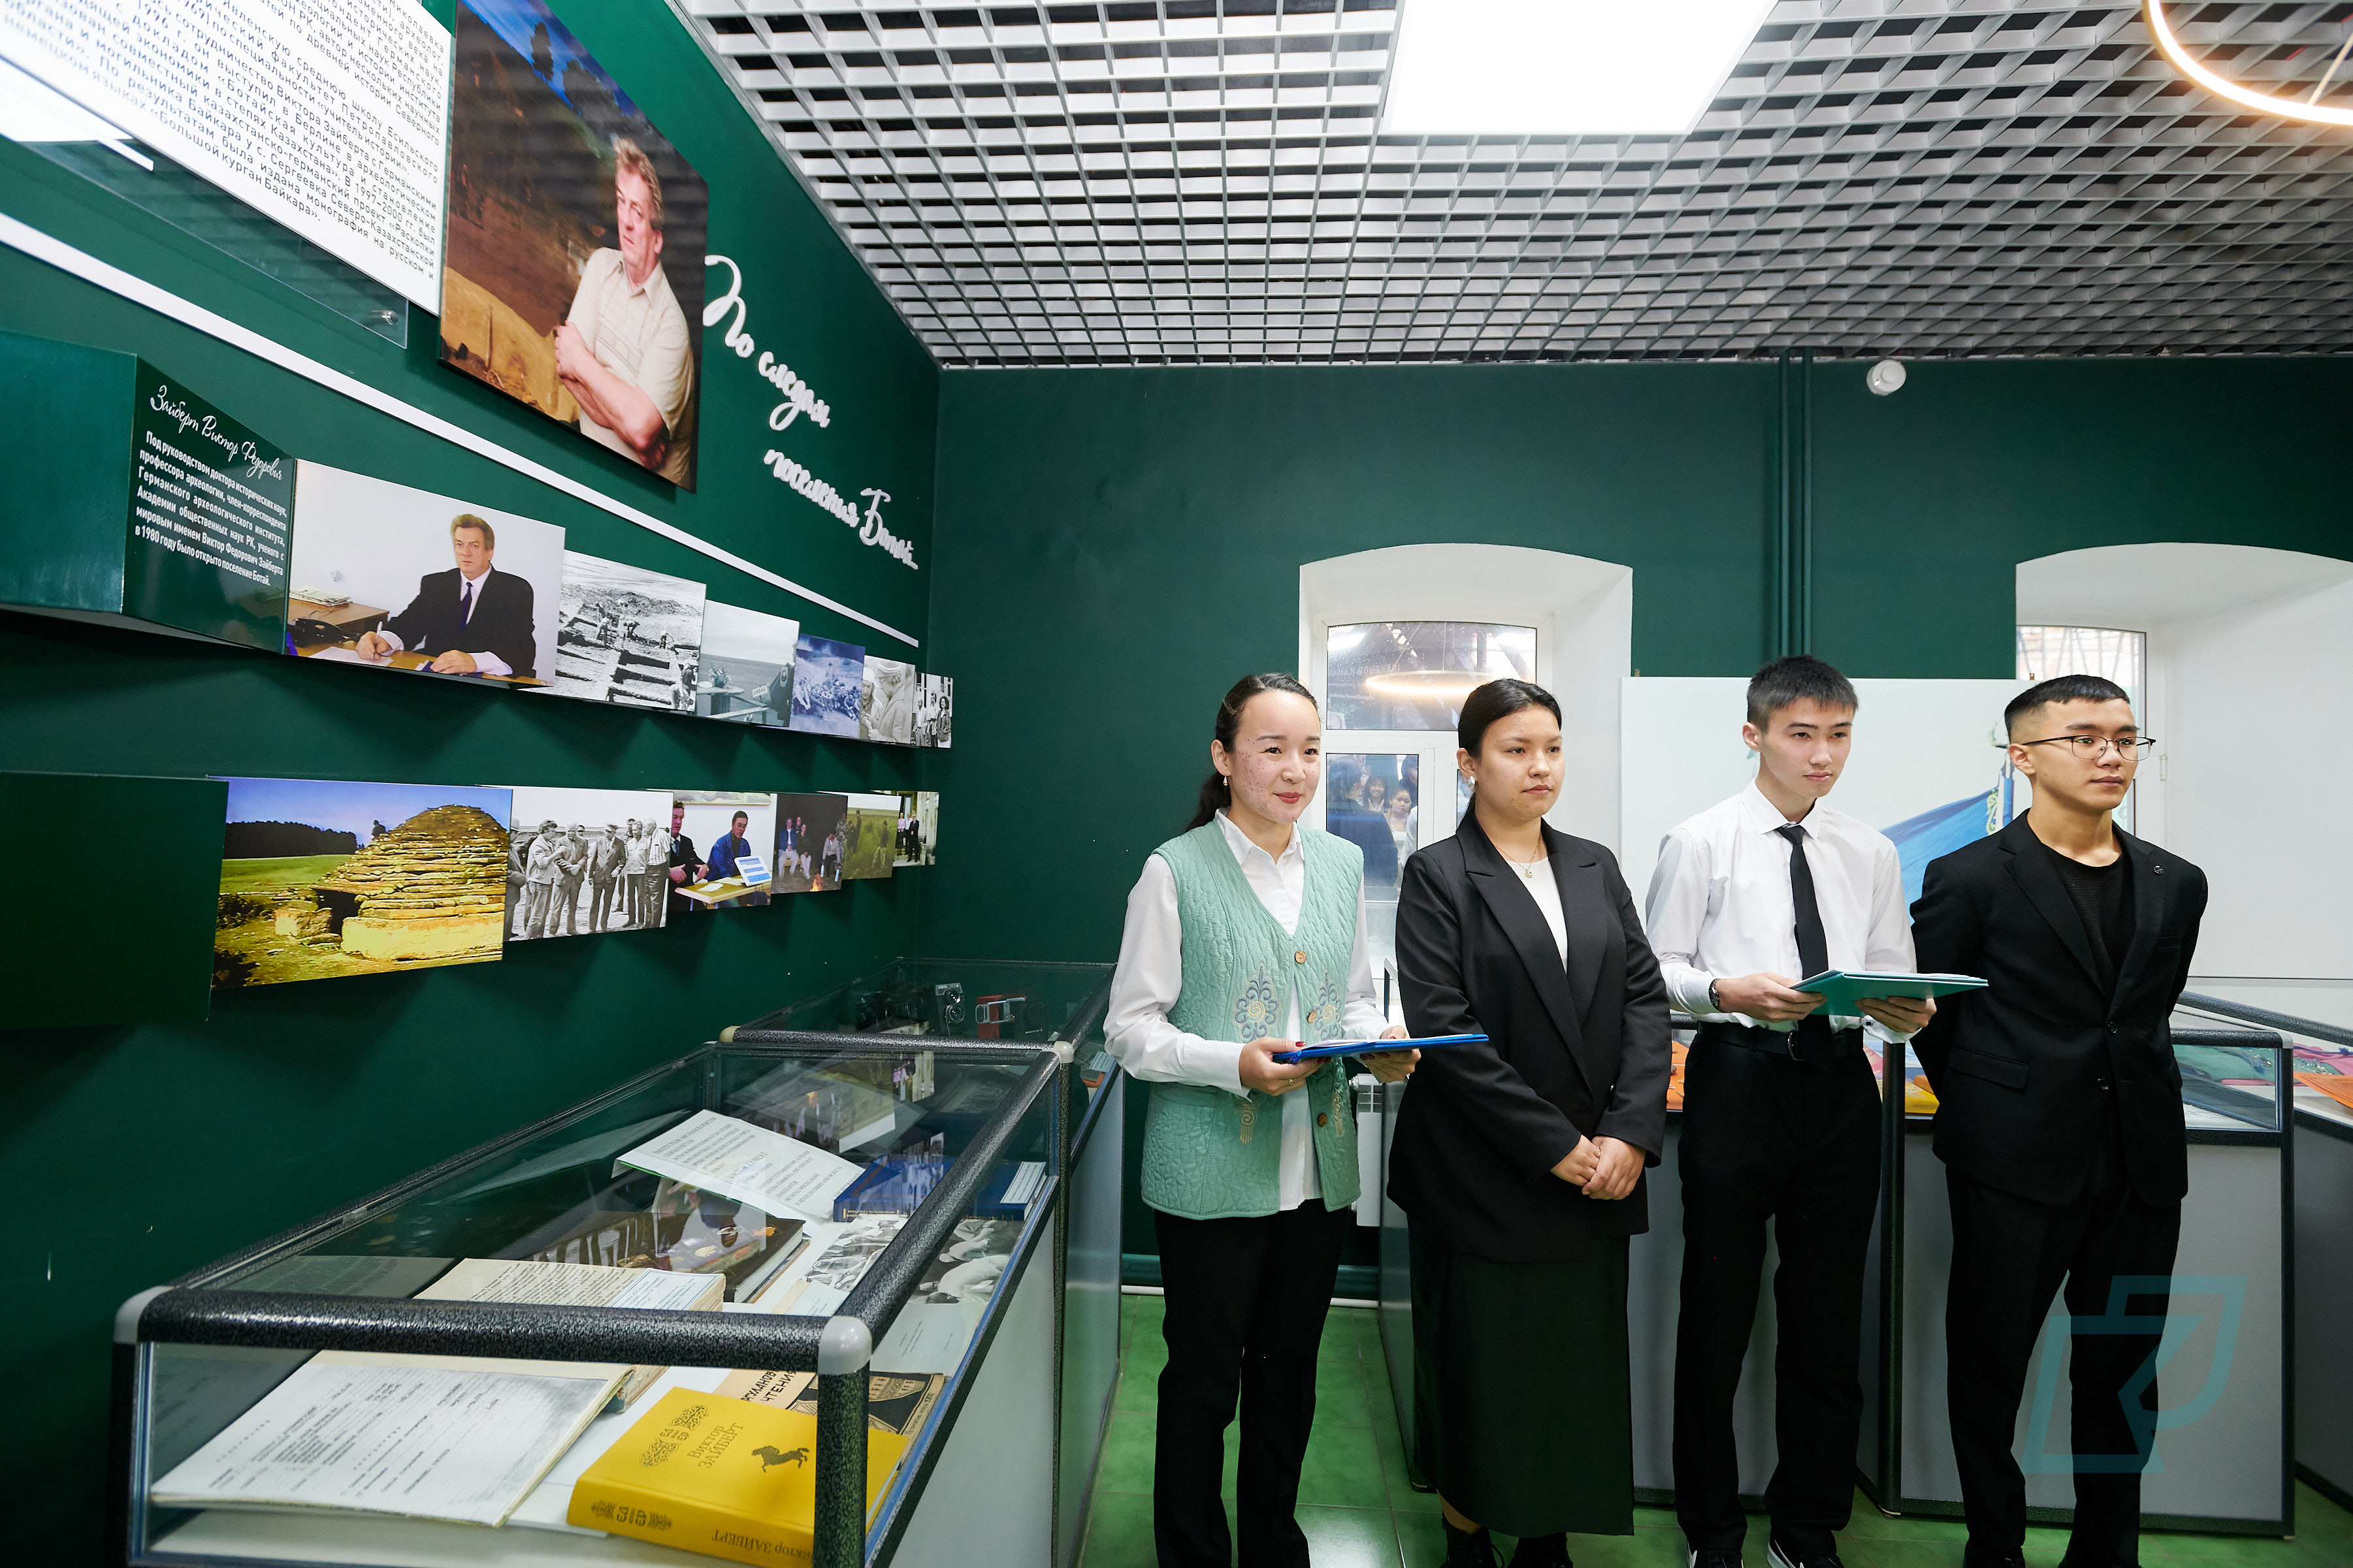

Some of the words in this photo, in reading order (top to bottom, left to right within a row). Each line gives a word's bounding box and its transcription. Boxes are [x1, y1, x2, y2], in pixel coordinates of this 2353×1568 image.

[280, 0, 295, 14] ОН
[299, 9, 316, 33] РК,
[319, 29, 347, 57] автор
[349, 54, 402, 103] нескольких
[404, 100, 439, 135] научных
[327, 0, 371, 37] ондент
[377, 36, 441, 99] Германского
[347, 0, 414, 63] исторических
[419, 63, 442, 89] наук,
[358, 48, 395, 84] истории
[399, 84, 440, 123] института
[368, 44, 389, 67] наук
[391, 61, 440, 110] Республики
[400, 20, 443, 66] археолог,
[408, 40, 428, 63] века
[131, 14, 208, 73] докладом
[217, 75, 295, 135] «Ботайская
[302, 134, 354, 176] культура
[372, 184, 435, 233] становление
[152, 0, 171, 15] сь
[175, 12, 273, 90] сотрудничество
[276, 84, 321, 125] Виктора
[323, 120, 369, 161] Зайберта
[378, 159, 436, 210] Германскими
[195, 0, 263, 50] ический
[270, 50, 334, 104] факультет
[341, 103, 437, 184] Петропавловского
[229, 33, 315, 104] специальности
[317, 101, 363, 140] «учитель
[365, 136, 409, 175] истории».
[297, 57, 346, 100] среднюю
[351, 99, 382, 130] школу
[387, 125, 438, 172] Есильского
[306, 33, 349, 73] древней
[354, 71, 391, 107] истории
[395, 103, 439, 146] Северного
[96, 39, 182, 102] могильника
[188, 97, 241, 141] Байкара
[270, 152, 326, 198] Сергеевка
[331, 193, 434, 268] Северо-Казахстанской
[112, 33, 197, 97] совместный
[203, 95, 349, 199] казахстанско-германский
[353, 197, 385, 223] проект
[389, 222, 434, 255] «Раскопки
[127, 76, 214, 139] результатам
[221, 135, 253, 164] была
[260, 162, 300, 195] издана
[306, 192, 368, 238] монография
[389, 246, 423, 274] русском
[150, 108, 219, 157] «Большой
[221, 152, 261, 184] курган
[264, 176, 320, 221] Байкара».
[217, 58, 276, 106] выступил
[295, 112, 340, 153] Берлине
[357, 160, 435, 221] археологическом
[226, 95, 266, 129] степях
[270, 123, 340, 180] Казахстана».
[355, 182, 402, 222] 1997-2000
[405, 219, 415, 232] гг.
[418, 227, 434, 245] был
[146, 430, 161, 451] Под
[161, 441, 210, 475] руководством
[209, 468, 235, 489] доктора
[235, 482, 274, 509] исторических
[272, 502, 287, 518] наук,
[150, 385, 199, 434] Зайберт
[201, 415, 238, 462] Виктор
[241, 441, 283, 481] Федорович
[137, 485, 176, 513] Академии
[178, 506, 228, 536] общественных
[229, 529, 244, 543] наук
[246, 535, 255, 550] РК,
[257, 541, 279, 558] ученого
[280, 552, 284, 561] с
[138, 465, 190, 501] Германского
[193, 494, 253, 530] археологического
[254, 524, 285, 547] института,
[139, 449, 184, 480] профессора
[185, 473, 225, 502] археологии,
[226, 494, 286, 531] член-корреспондента
[135, 505, 172, 530] мировым
[173, 522, 201, 541] именем
[201, 531, 225, 553] Виктор
[225, 542, 258, 565] Федорович
[258, 556, 284, 575] Зайберта
[135, 524, 140, 536] в
[141, 524, 159, 543] 1980
[159, 535, 176, 552] году
[176, 539, 195, 556] было
[195, 549, 221, 567] открыто
[221, 560, 253, 579] поселение
[252, 569, 270, 586] Ботай.
[687, 1426, 726, 1459] Виктор
[698, 1423, 744, 1469] ЗАЙБЕРТ
[711, 1530, 772, 1554] ЗАЙБЕРТ
[774, 1542, 814, 1560] иктор
